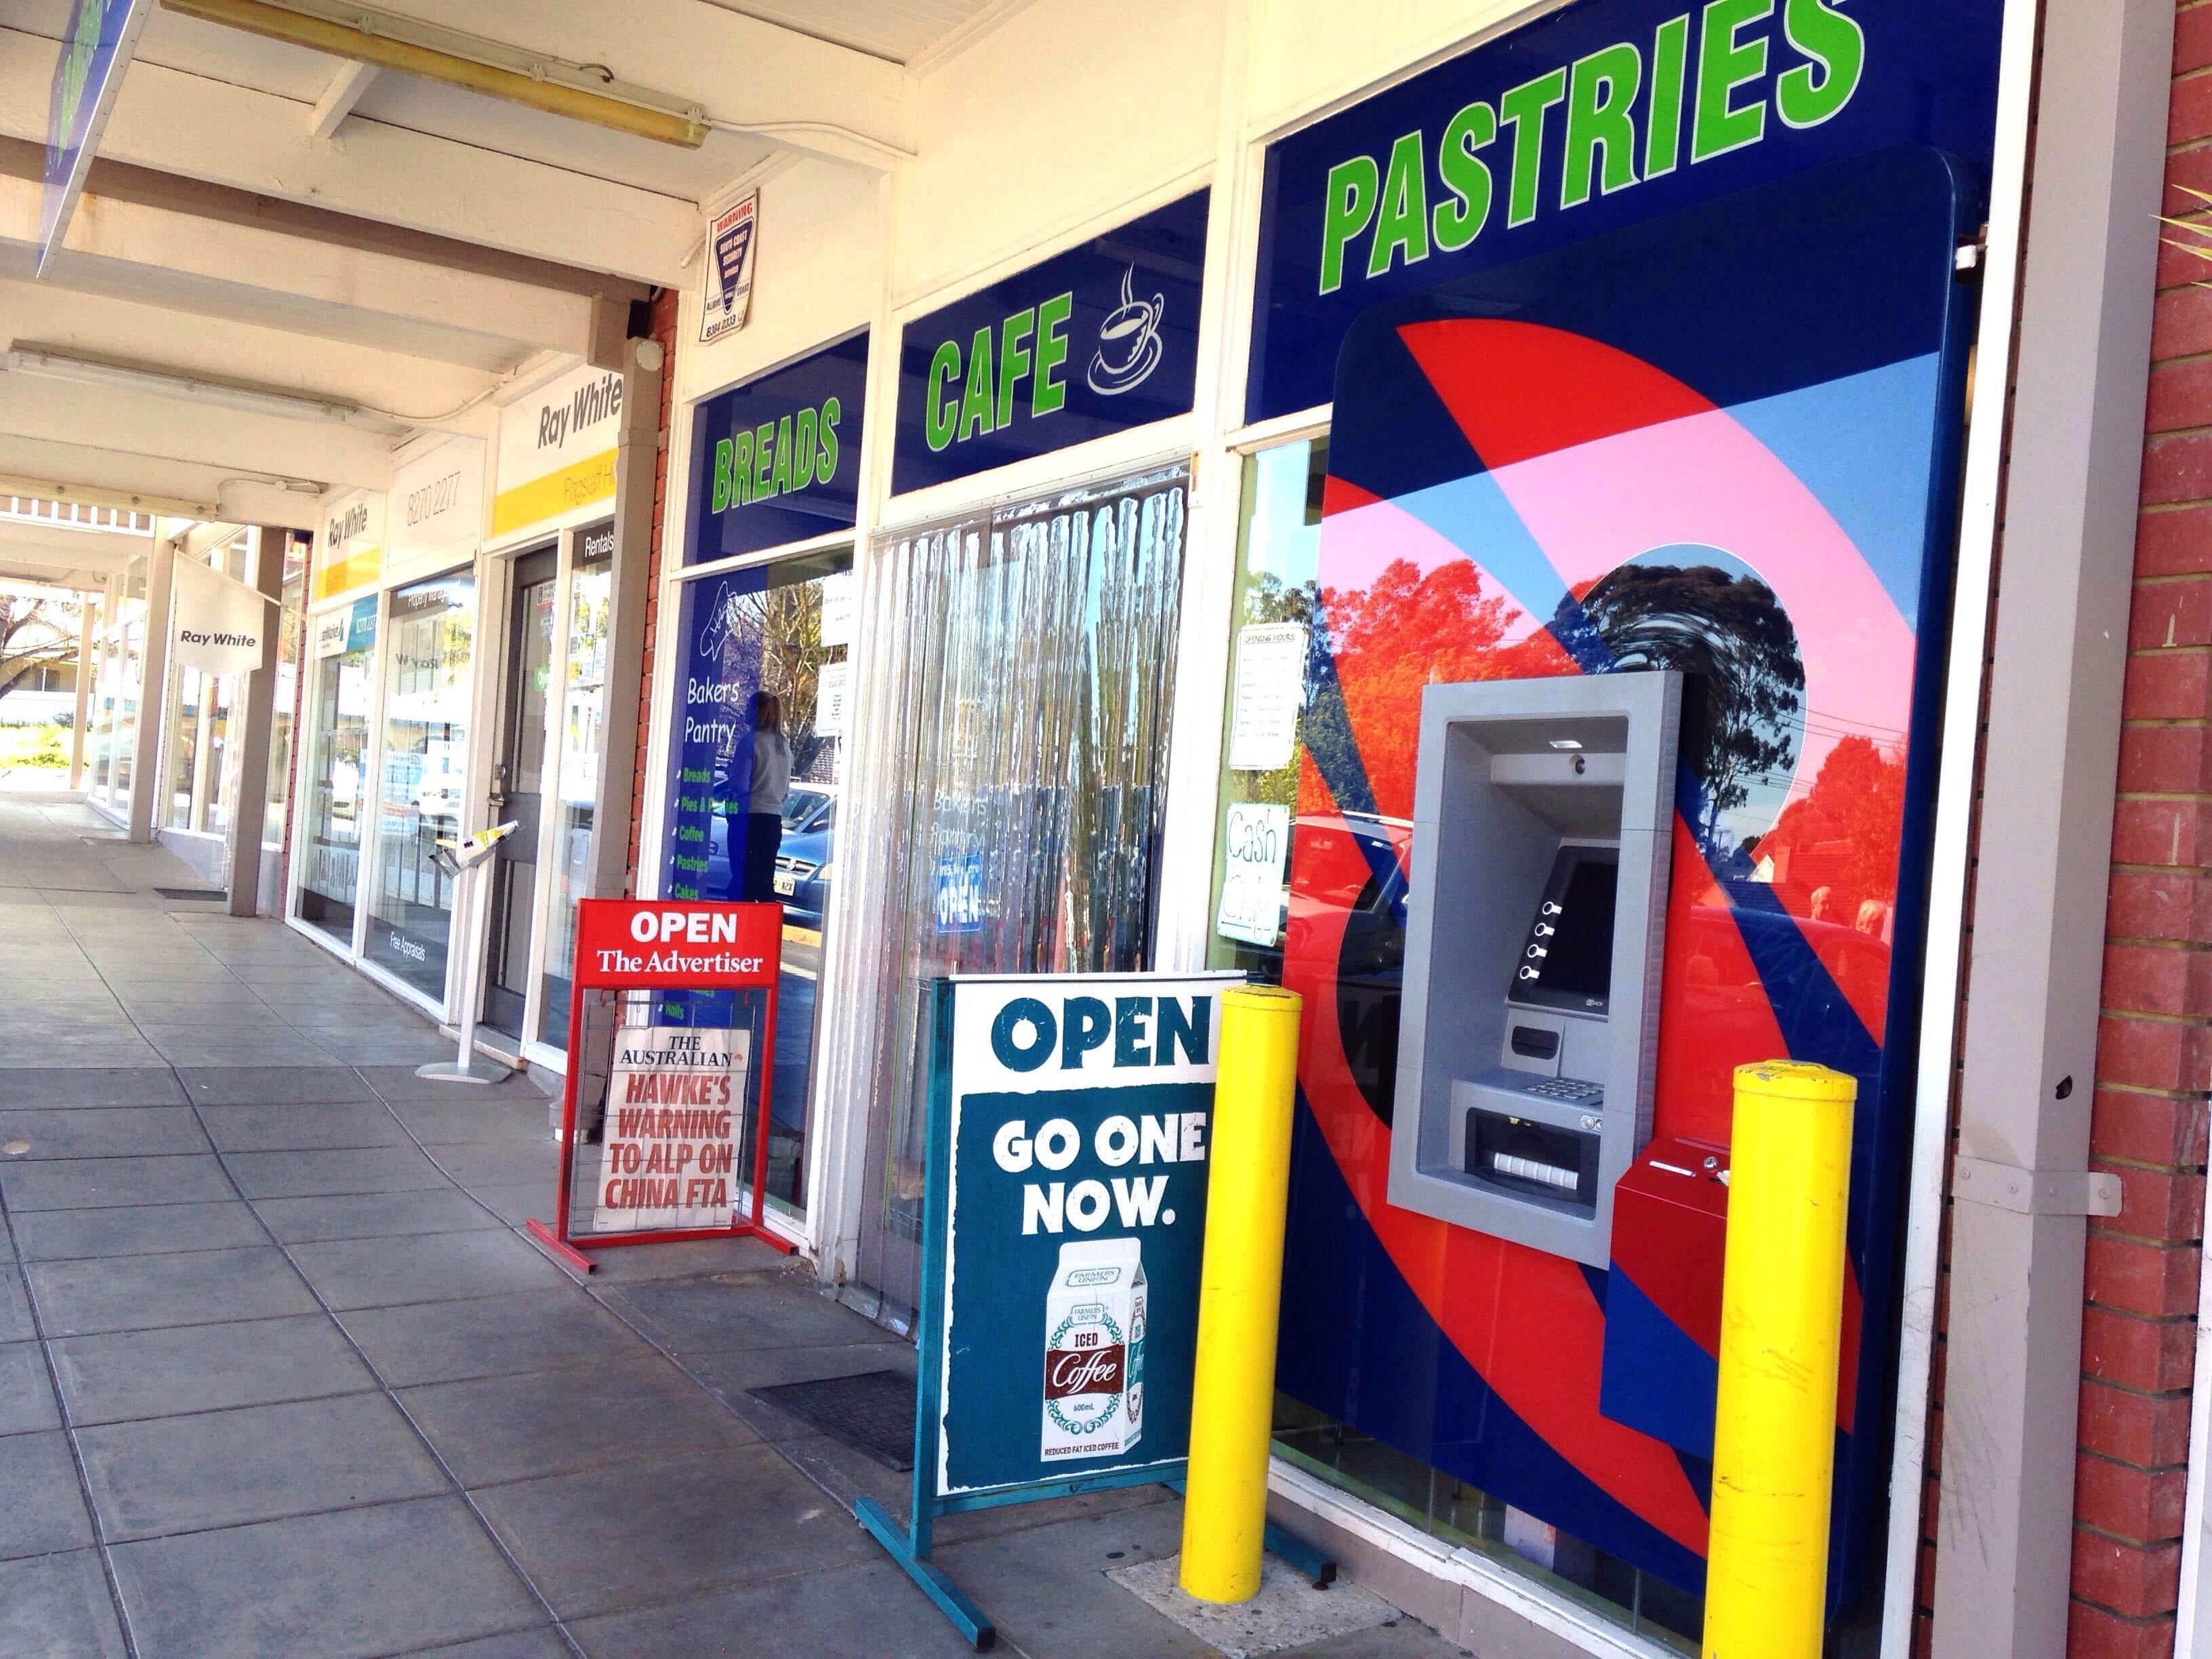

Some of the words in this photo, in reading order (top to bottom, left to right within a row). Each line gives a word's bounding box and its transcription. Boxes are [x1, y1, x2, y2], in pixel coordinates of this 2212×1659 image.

[1318, 0, 1866, 296] PASTRIES
[717, 202, 752, 232] WARNING
[926, 291, 1073, 452] CAFE
[537, 405, 571, 449] Ray
[573, 373, 623, 433] White
[712, 396, 841, 515] BREADS
[407, 485, 432, 527] 8270
[433, 471, 461, 516] 2277
[328, 517, 344, 550] Ray
[344, 503, 367, 540] White
[585, 531, 613, 558] Rentals
[181, 630, 211, 646] Ray
[213, 633, 256, 647] White
[687, 676, 740, 705] Bakers
[684, 716, 736, 747] Pantry
[683, 766, 710, 783] Breads
[681, 796, 698, 812] Pies
[679, 824, 705, 842] Coffee
[1229, 807, 1277, 864] Cash
[676, 854, 709, 874] Pastries
[674, 882, 699, 901] Cakes
[939, 885, 980, 926] OPEN
[390, 930, 401, 951] Free
[630, 912, 737, 943] OPEN
[597, 950, 643, 973] The
[644, 951, 764, 973] Advertiser
[669, 1036, 701, 1050] THE
[991, 995, 1214, 1072] OPEN
[619, 1050, 733, 1067] AUSTRALIAN
[626, 1073, 731, 1105] HAWKE'S
[618, 1108, 731, 1139] WARNING
[992, 1118, 1080, 1173] GO
[1094, 1112, 1206, 1167] ONE
[610, 1143, 641, 1174] TO
[645, 1143, 693, 1174] ALP
[699, 1143, 733, 1174] ON
[605, 1178, 678, 1210] CHINA
[685, 1178, 727, 1209] FTA
[1021, 1175, 1176, 1235] NOW.
[1074, 1271, 1115, 1279] FARMERS
[1075, 1332, 1099, 1347] ICED
[1052, 1350, 1118, 1395] Coffee
[1073, 1402, 1095, 1412] 600mL
[1044, 1446, 1071, 1456] REDUCED
[1072, 1445, 1083, 1454] FAT
[1084, 1444, 1097, 1452] ICED
[1097, 1442, 1119, 1451] COFFEE
